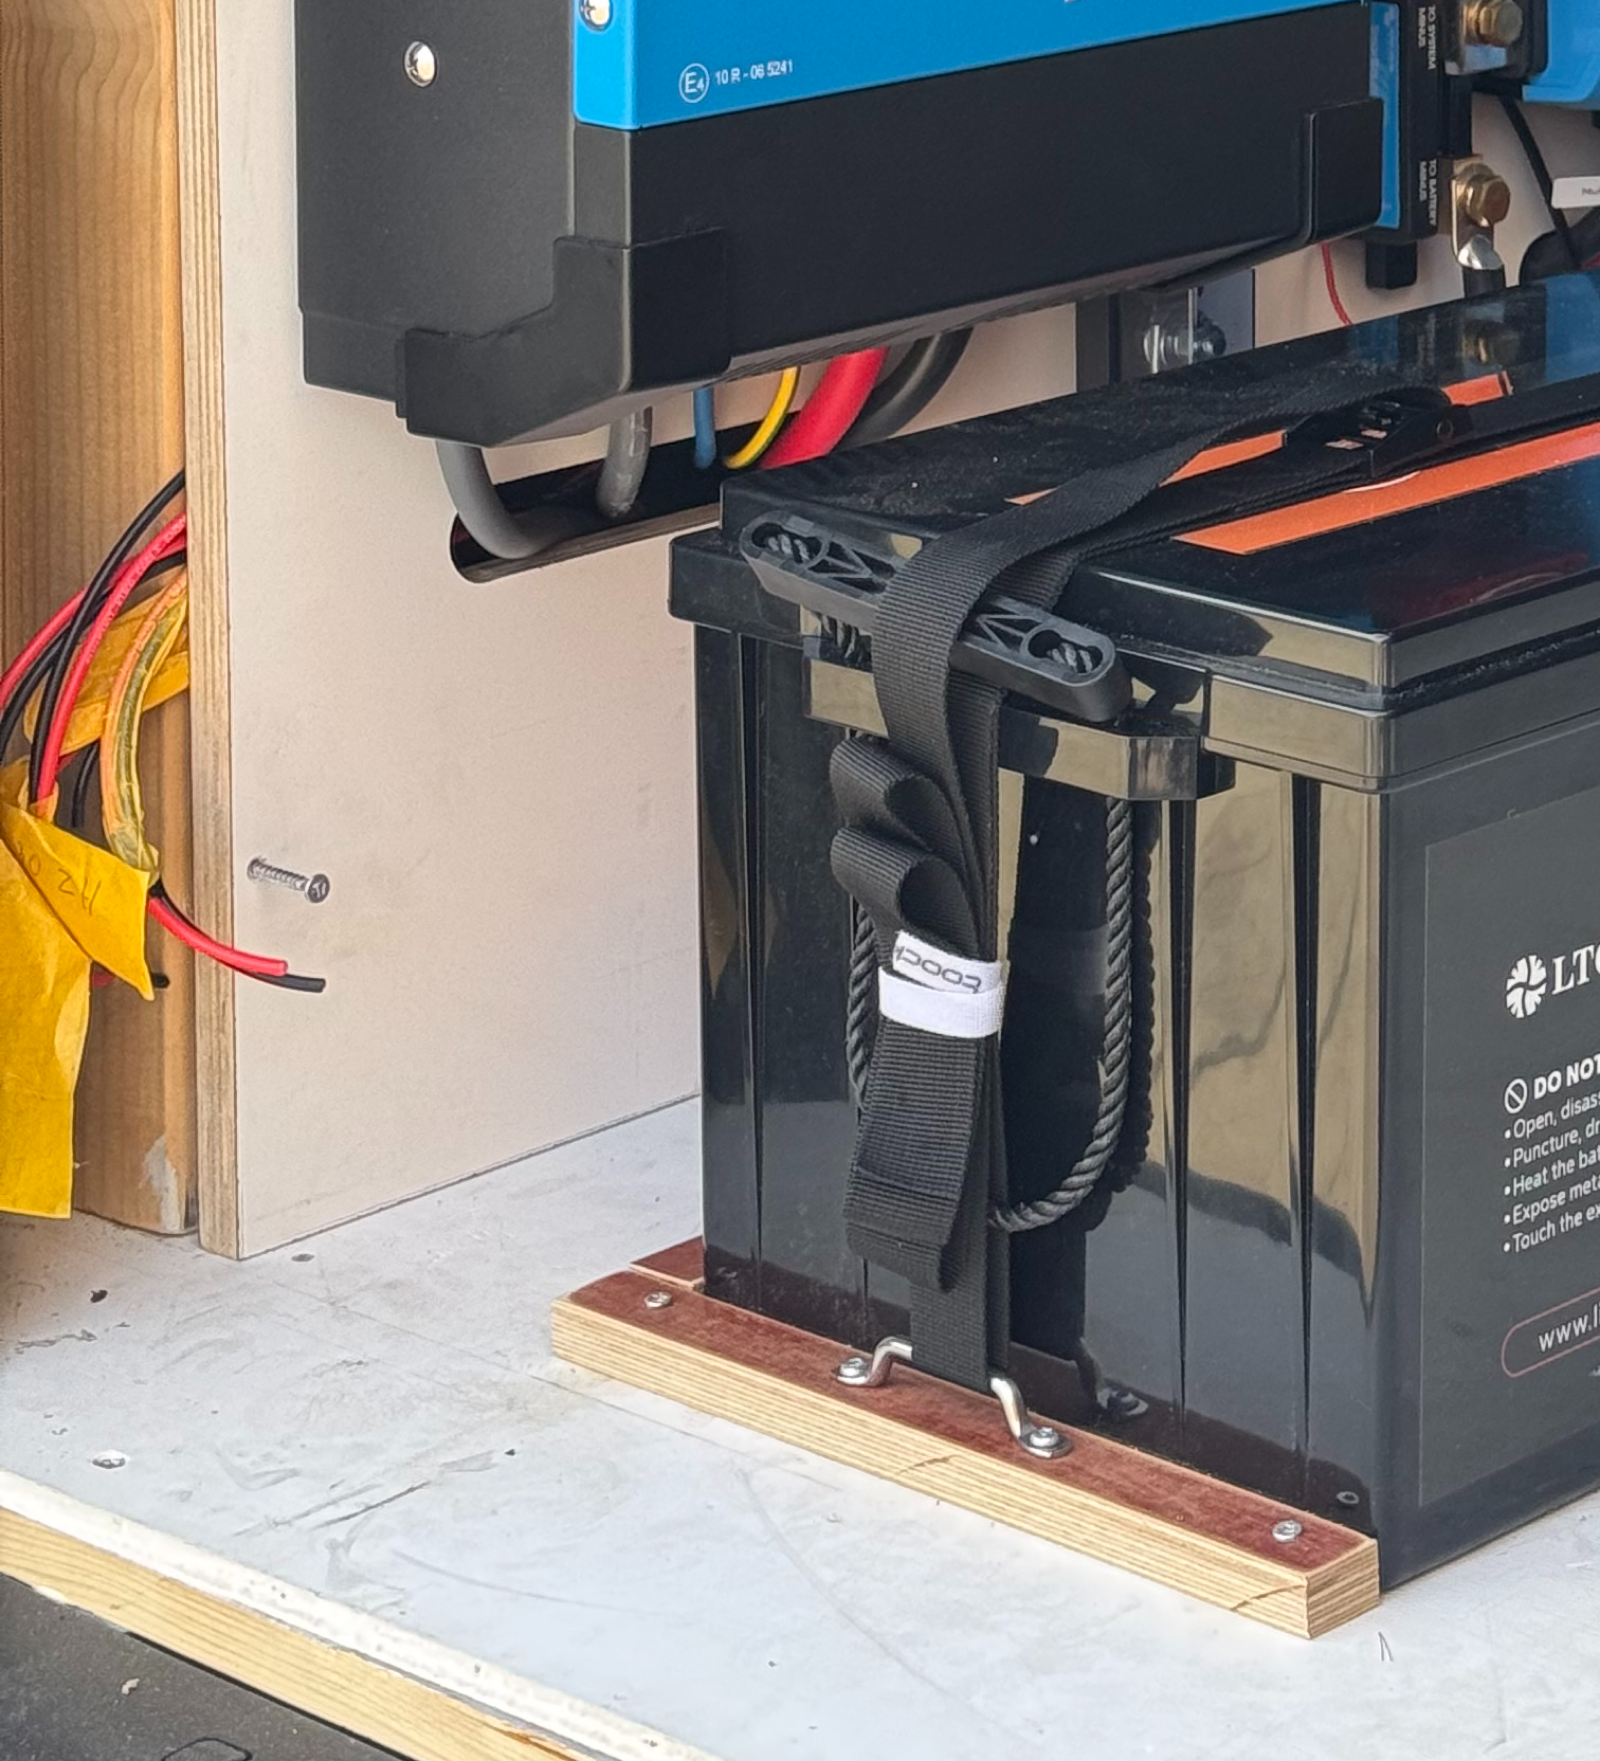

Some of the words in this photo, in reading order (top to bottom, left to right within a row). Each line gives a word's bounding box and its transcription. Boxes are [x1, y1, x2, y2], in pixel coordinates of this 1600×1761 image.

[715, 68, 729, 85] 10
[750, 63, 765, 80] 06
[767, 59, 793, 77] 5241
[1533, 1070, 1562, 1100] DO
[1513, 1110, 1558, 1139] Open,
[1513, 1126, 1582, 1167] Puncture,
[1513, 1189, 1566, 1225] Expose
[1513, 1219, 1557, 1253] Touch
[1559, 1209, 1583, 1234] the
